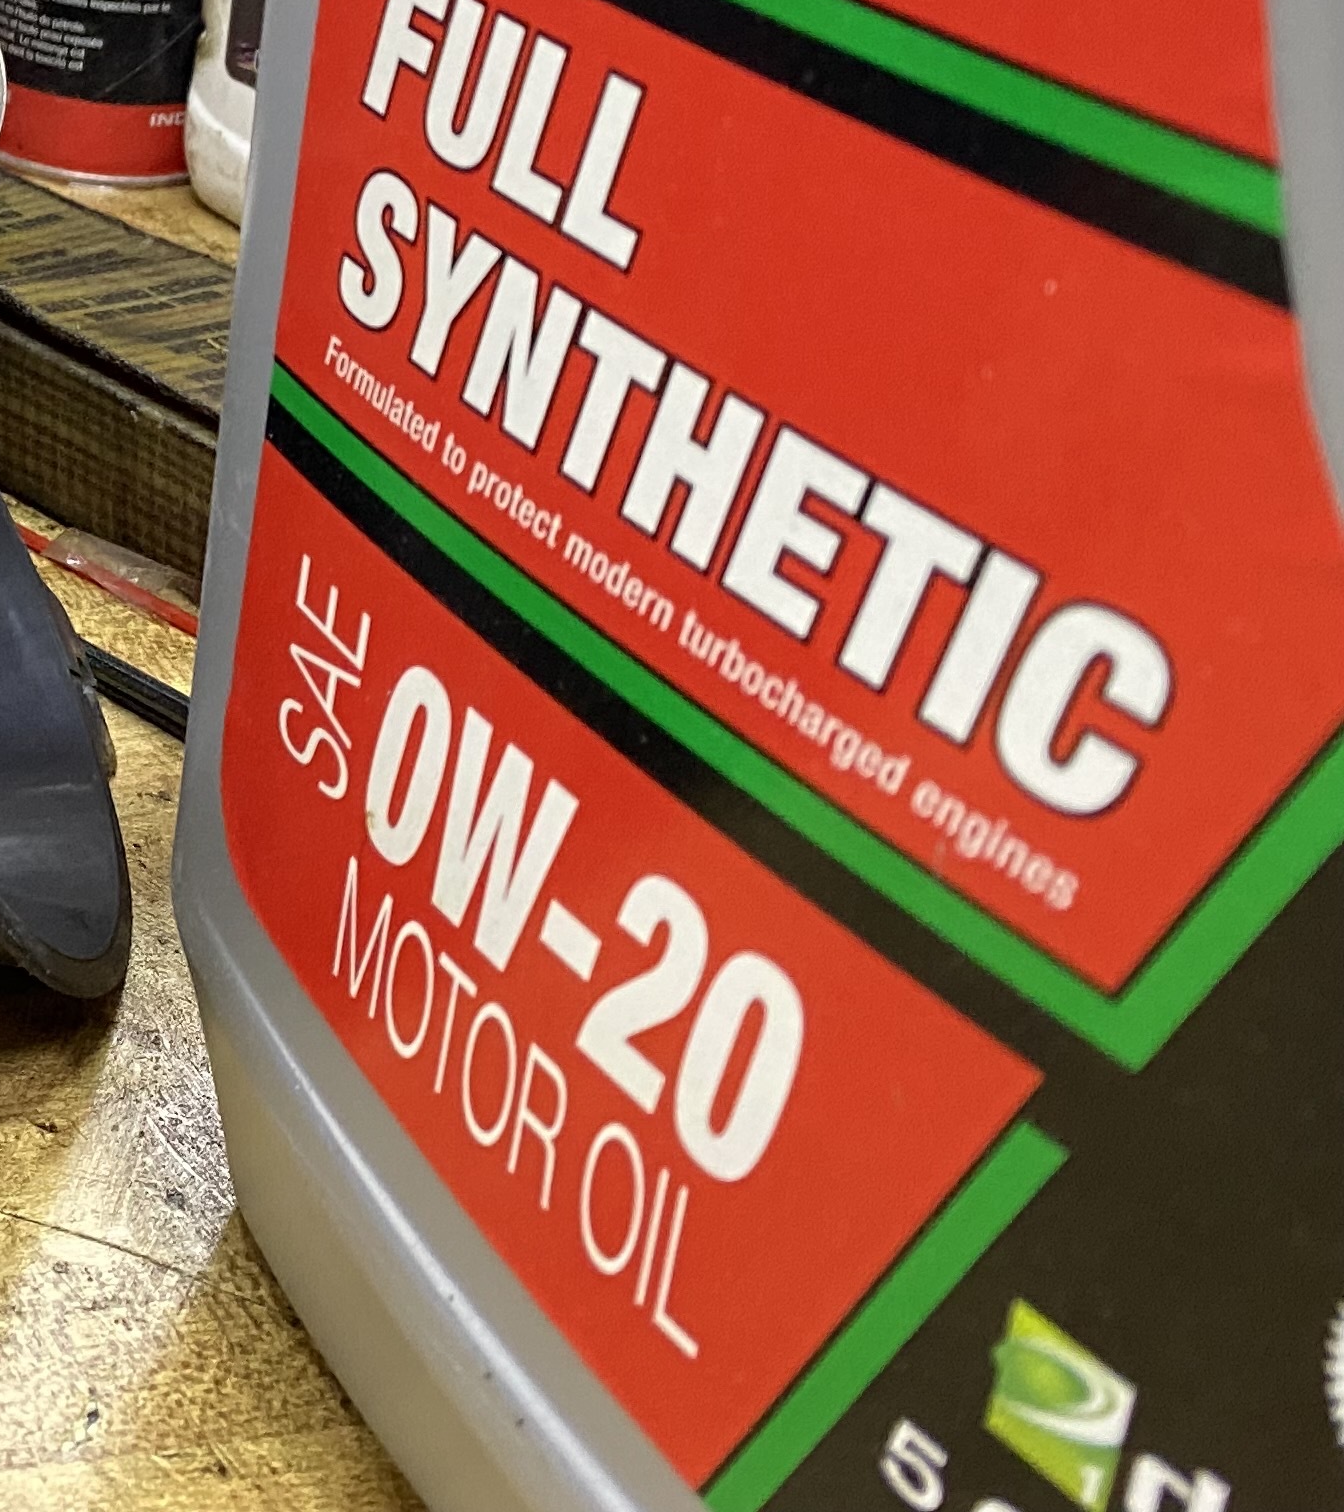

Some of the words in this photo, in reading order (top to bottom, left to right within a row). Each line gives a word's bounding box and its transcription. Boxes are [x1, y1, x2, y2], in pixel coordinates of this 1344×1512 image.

[277, 553, 372, 800] SAE
[323, 335, 442, 453] Formulated
[441, 433, 468, 476] to
[466, 458, 563, 550] protect
[563, 533, 675, 633] modern
[678, 609, 912, 795] turbocharged
[910, 778, 1081, 912] engines
[337, 169, 1176, 818] SYNTHETIC
[333, 854, 569, 1212] MOTOR
[579, 1122, 699, 1360] OIL
[365, 664, 806, 1184] 0W-20
